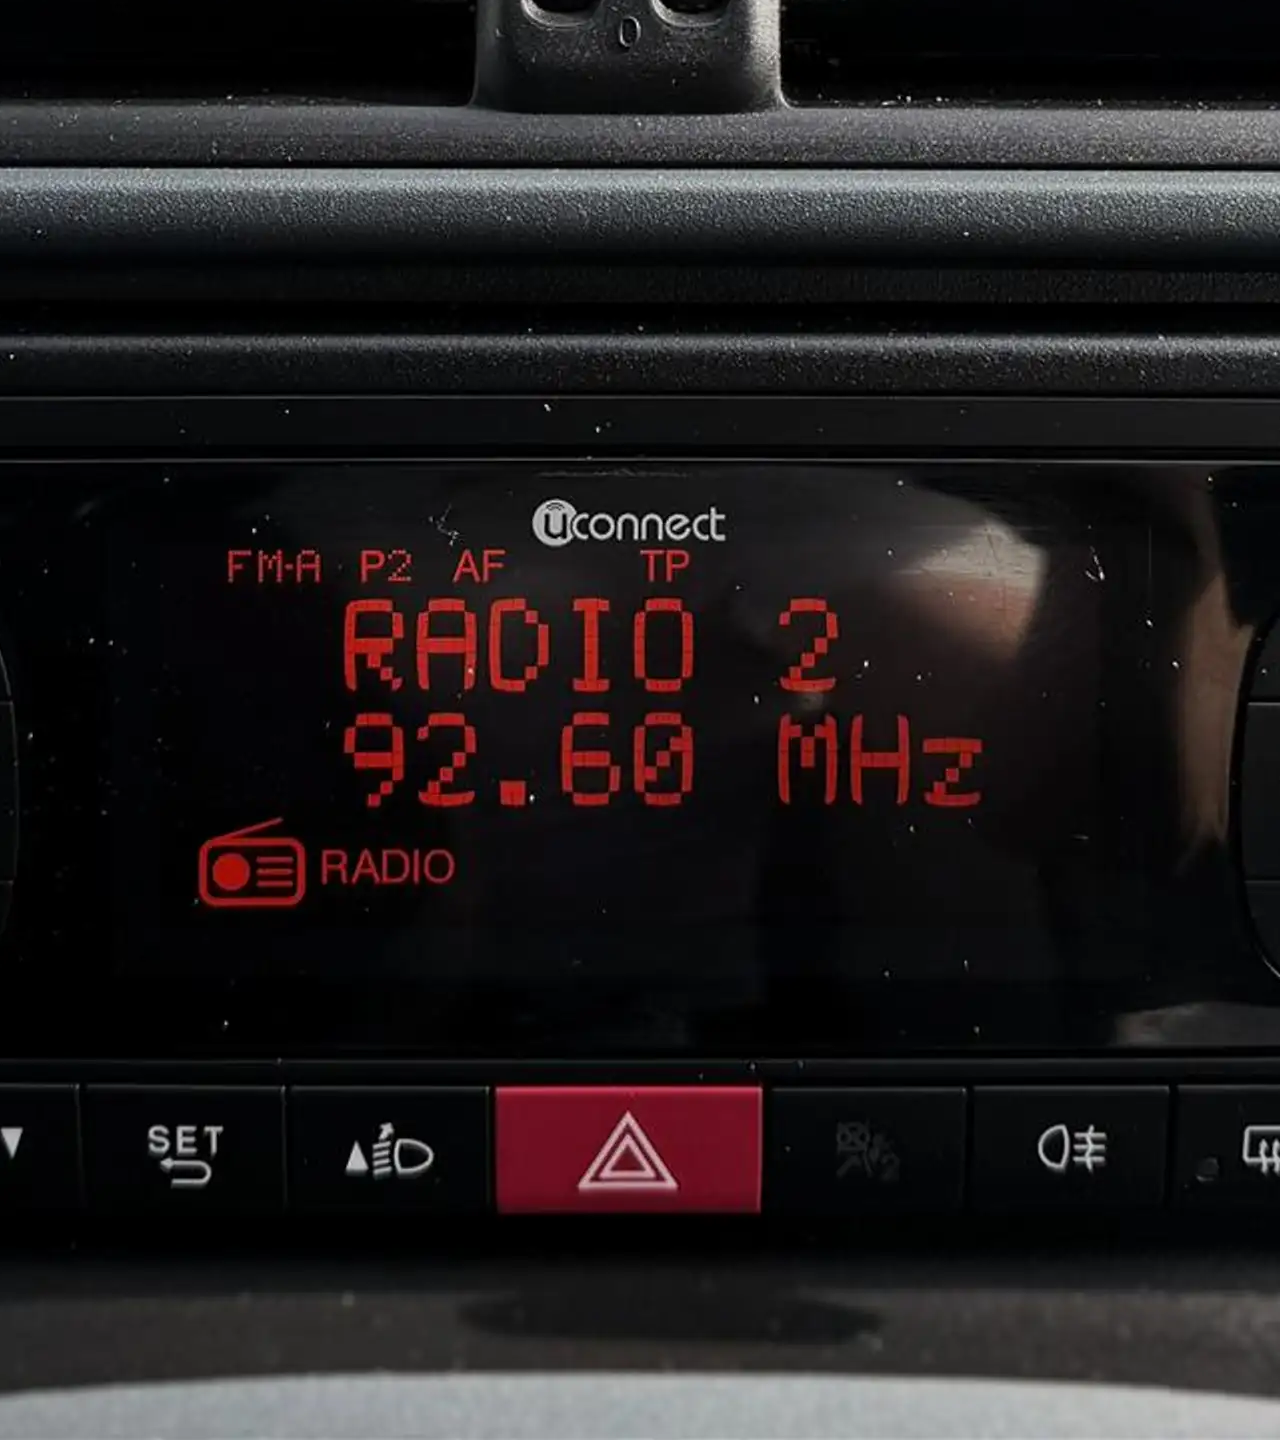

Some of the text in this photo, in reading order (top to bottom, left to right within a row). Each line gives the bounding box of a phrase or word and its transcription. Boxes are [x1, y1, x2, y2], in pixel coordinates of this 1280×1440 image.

[360, 549, 412, 583] P2
[453, 549, 506, 583] AF
[639, 549, 691, 583] TP
[344, 597, 839, 693] RADIO 2
[344, 712, 983, 807] 92.60 MHz
[321, 848, 456, 886] RADIO
[146, 1124, 225, 1157] SET
